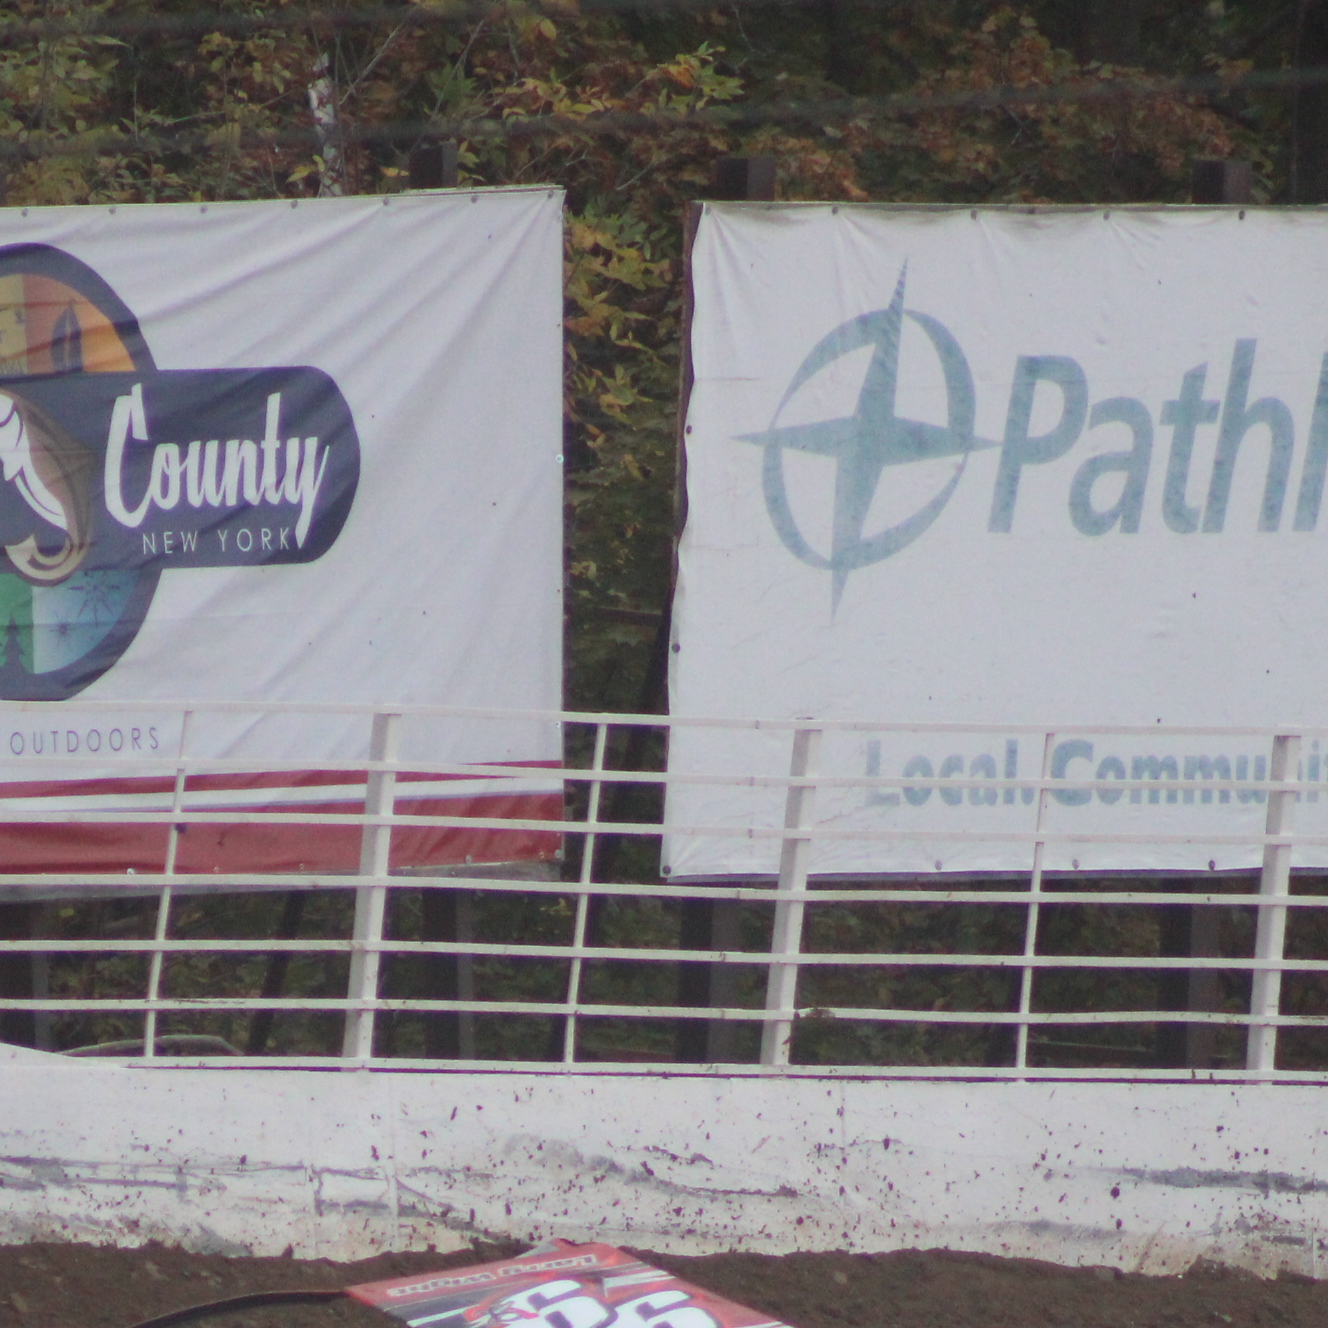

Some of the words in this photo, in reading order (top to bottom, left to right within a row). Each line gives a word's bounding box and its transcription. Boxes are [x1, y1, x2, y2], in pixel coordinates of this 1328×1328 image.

[104, 382, 330, 549] County
[143, 530, 198, 554] NEW
[217, 527, 291, 552] YORK
[10, 727, 159, 755] OUTDOORS
